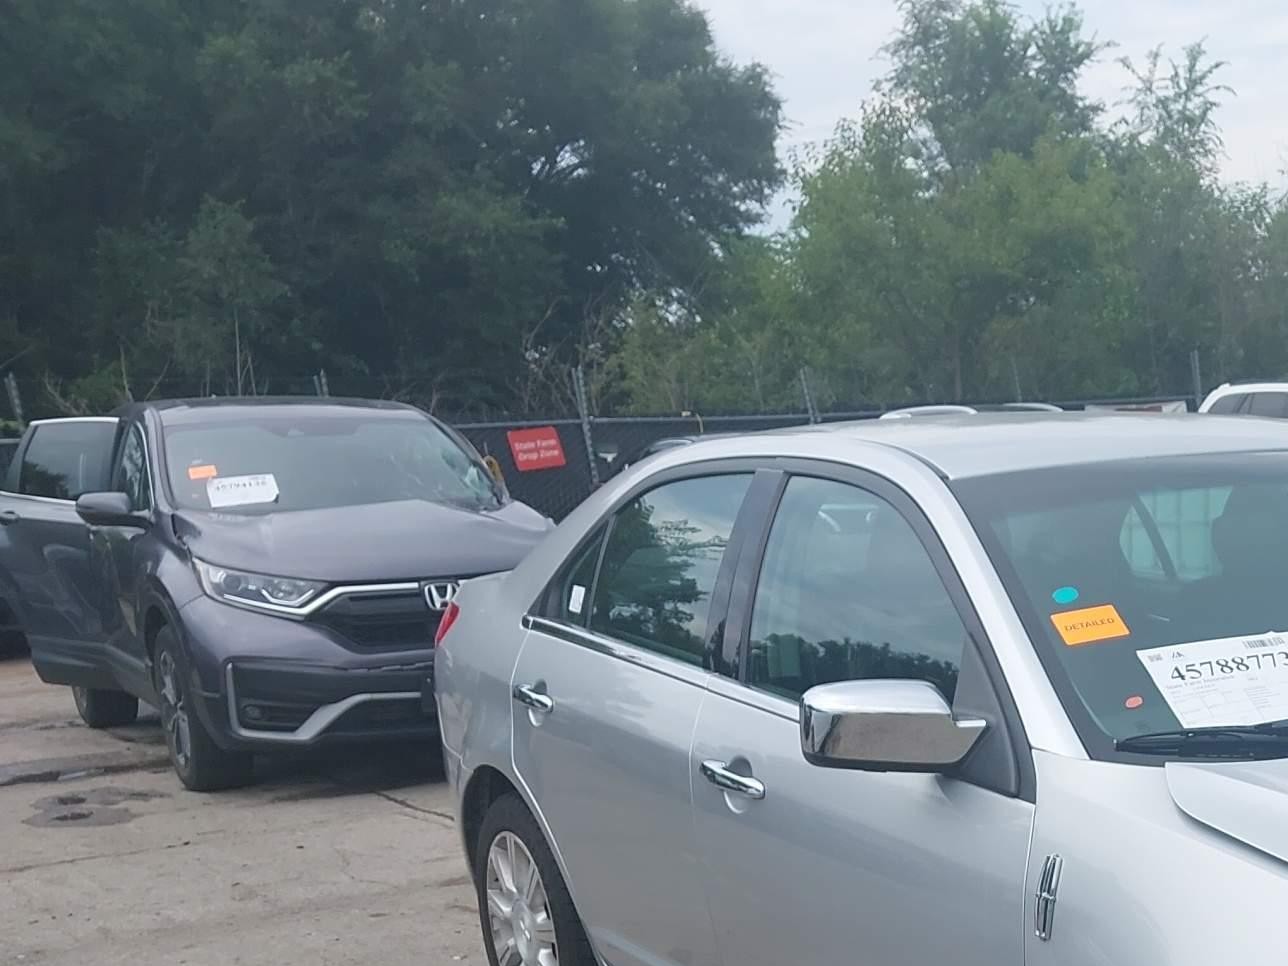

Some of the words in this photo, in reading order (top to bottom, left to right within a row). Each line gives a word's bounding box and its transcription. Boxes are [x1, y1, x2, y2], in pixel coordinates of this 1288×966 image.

[514, 441, 535, 450] State
[536, 439, 557, 448] Farm
[518, 452, 538, 462] Drop
[539, 450, 558, 458] Zone
[1064, 617, 1115, 631] DETAILED
